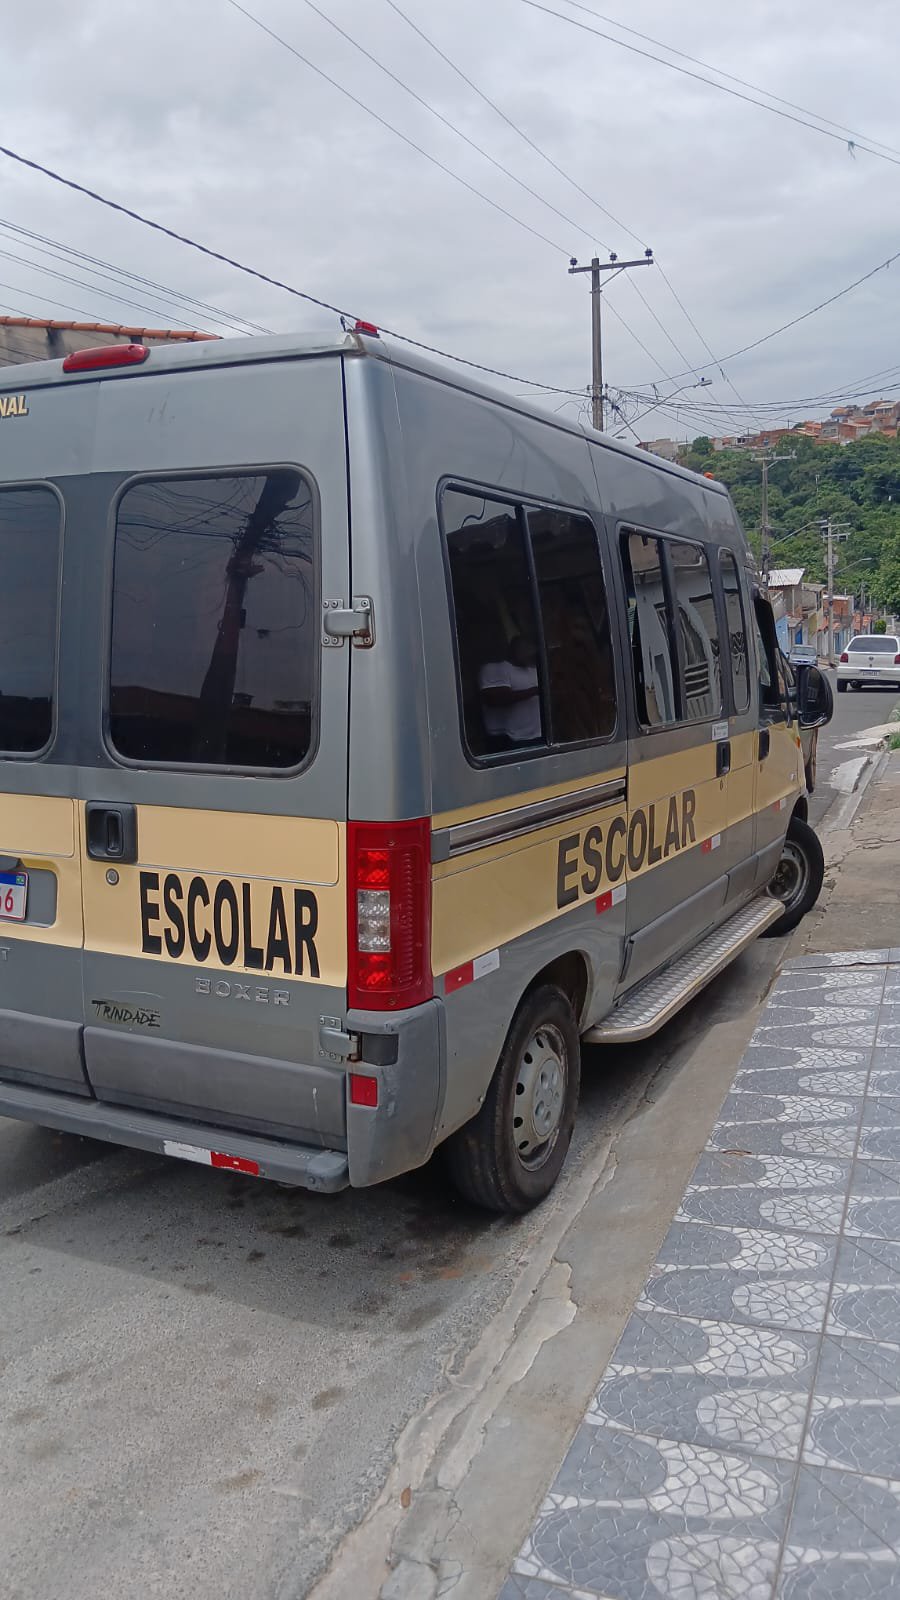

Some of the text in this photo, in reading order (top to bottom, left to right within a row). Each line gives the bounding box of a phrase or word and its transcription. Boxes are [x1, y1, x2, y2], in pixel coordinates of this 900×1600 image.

[557, 789, 696, 910] ESCOLAR
[139, 871, 321, 978] ESCOLAR
[91, 999, 161, 1028] TRINDADE
[194, 977, 290, 1006] BOXER
